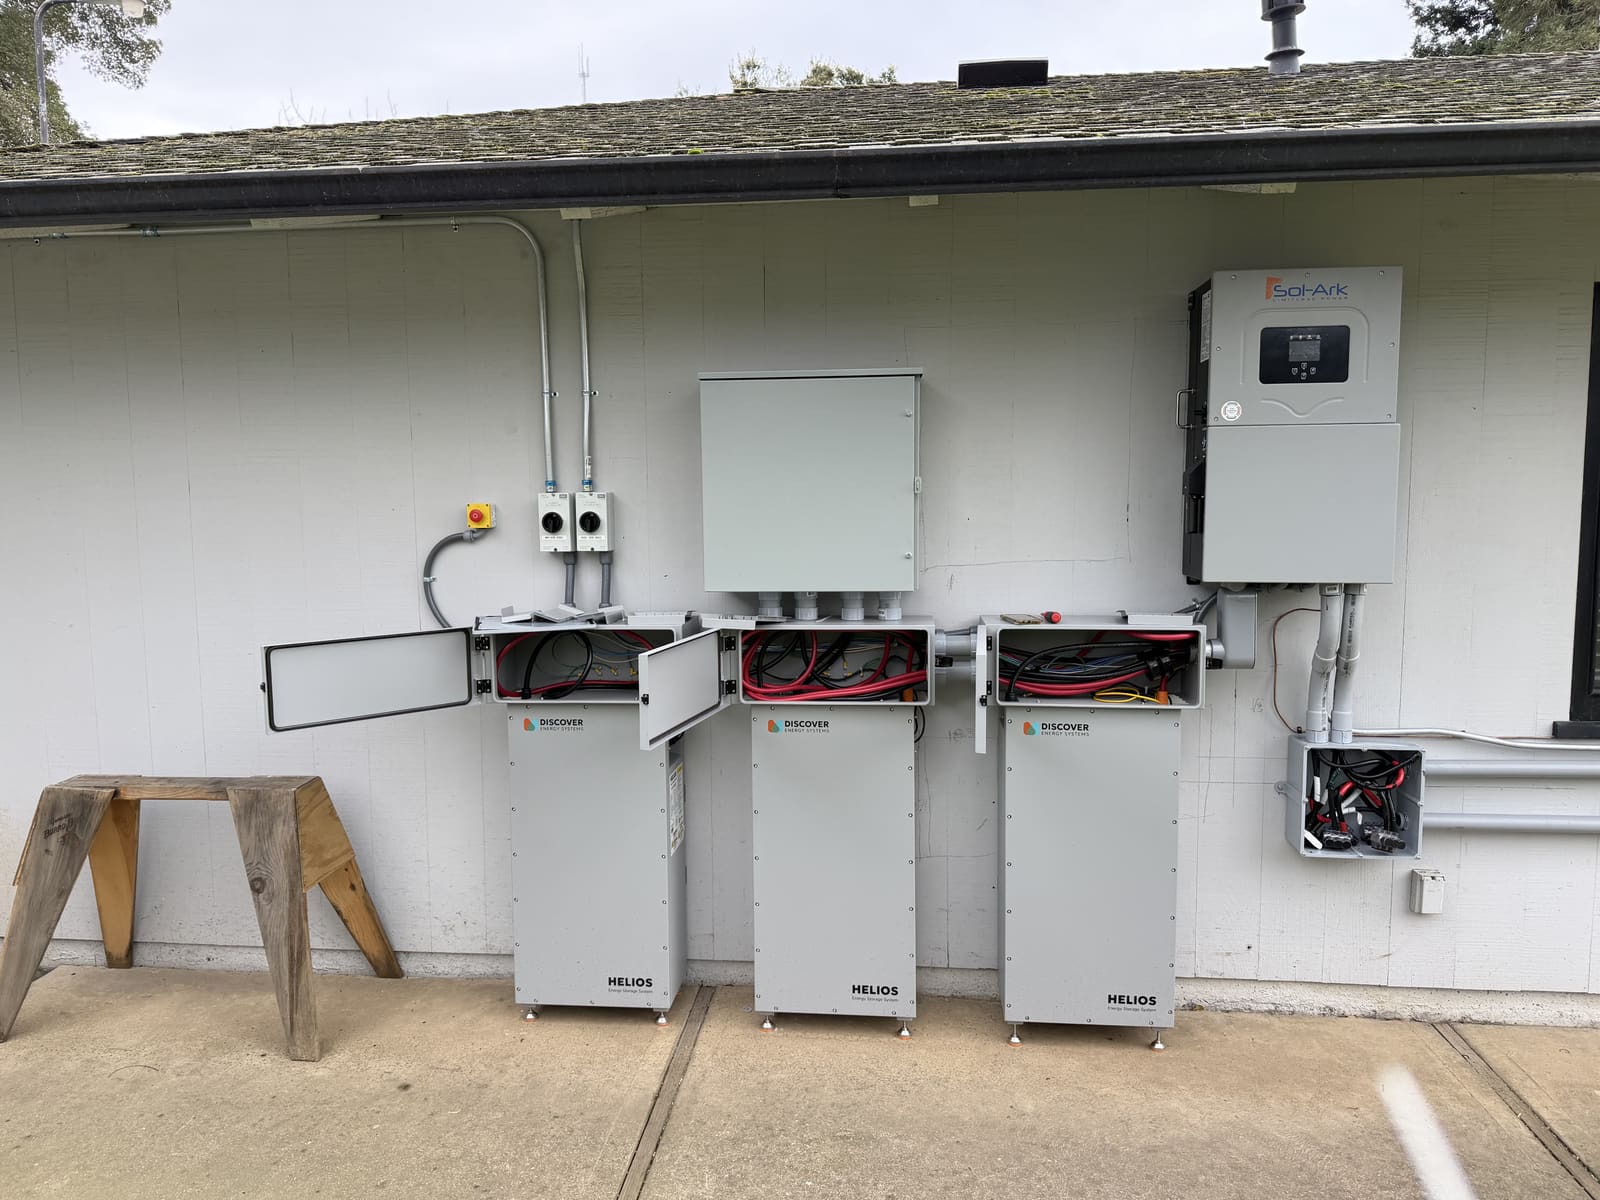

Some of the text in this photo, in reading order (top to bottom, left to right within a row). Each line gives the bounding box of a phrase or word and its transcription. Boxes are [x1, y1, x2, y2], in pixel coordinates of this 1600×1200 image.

[1273, 283, 1348, 297] Sol-Ark
[540, 718, 583, 726] DISCOVER
[785, 720, 829, 728] DISCOVER
[1041, 723, 1089, 731] DISCOVER
[608, 977, 653, 987] HELIOS
[852, 984, 898, 995] HELIOS
[1108, 994, 1156, 1005] HELIOS
